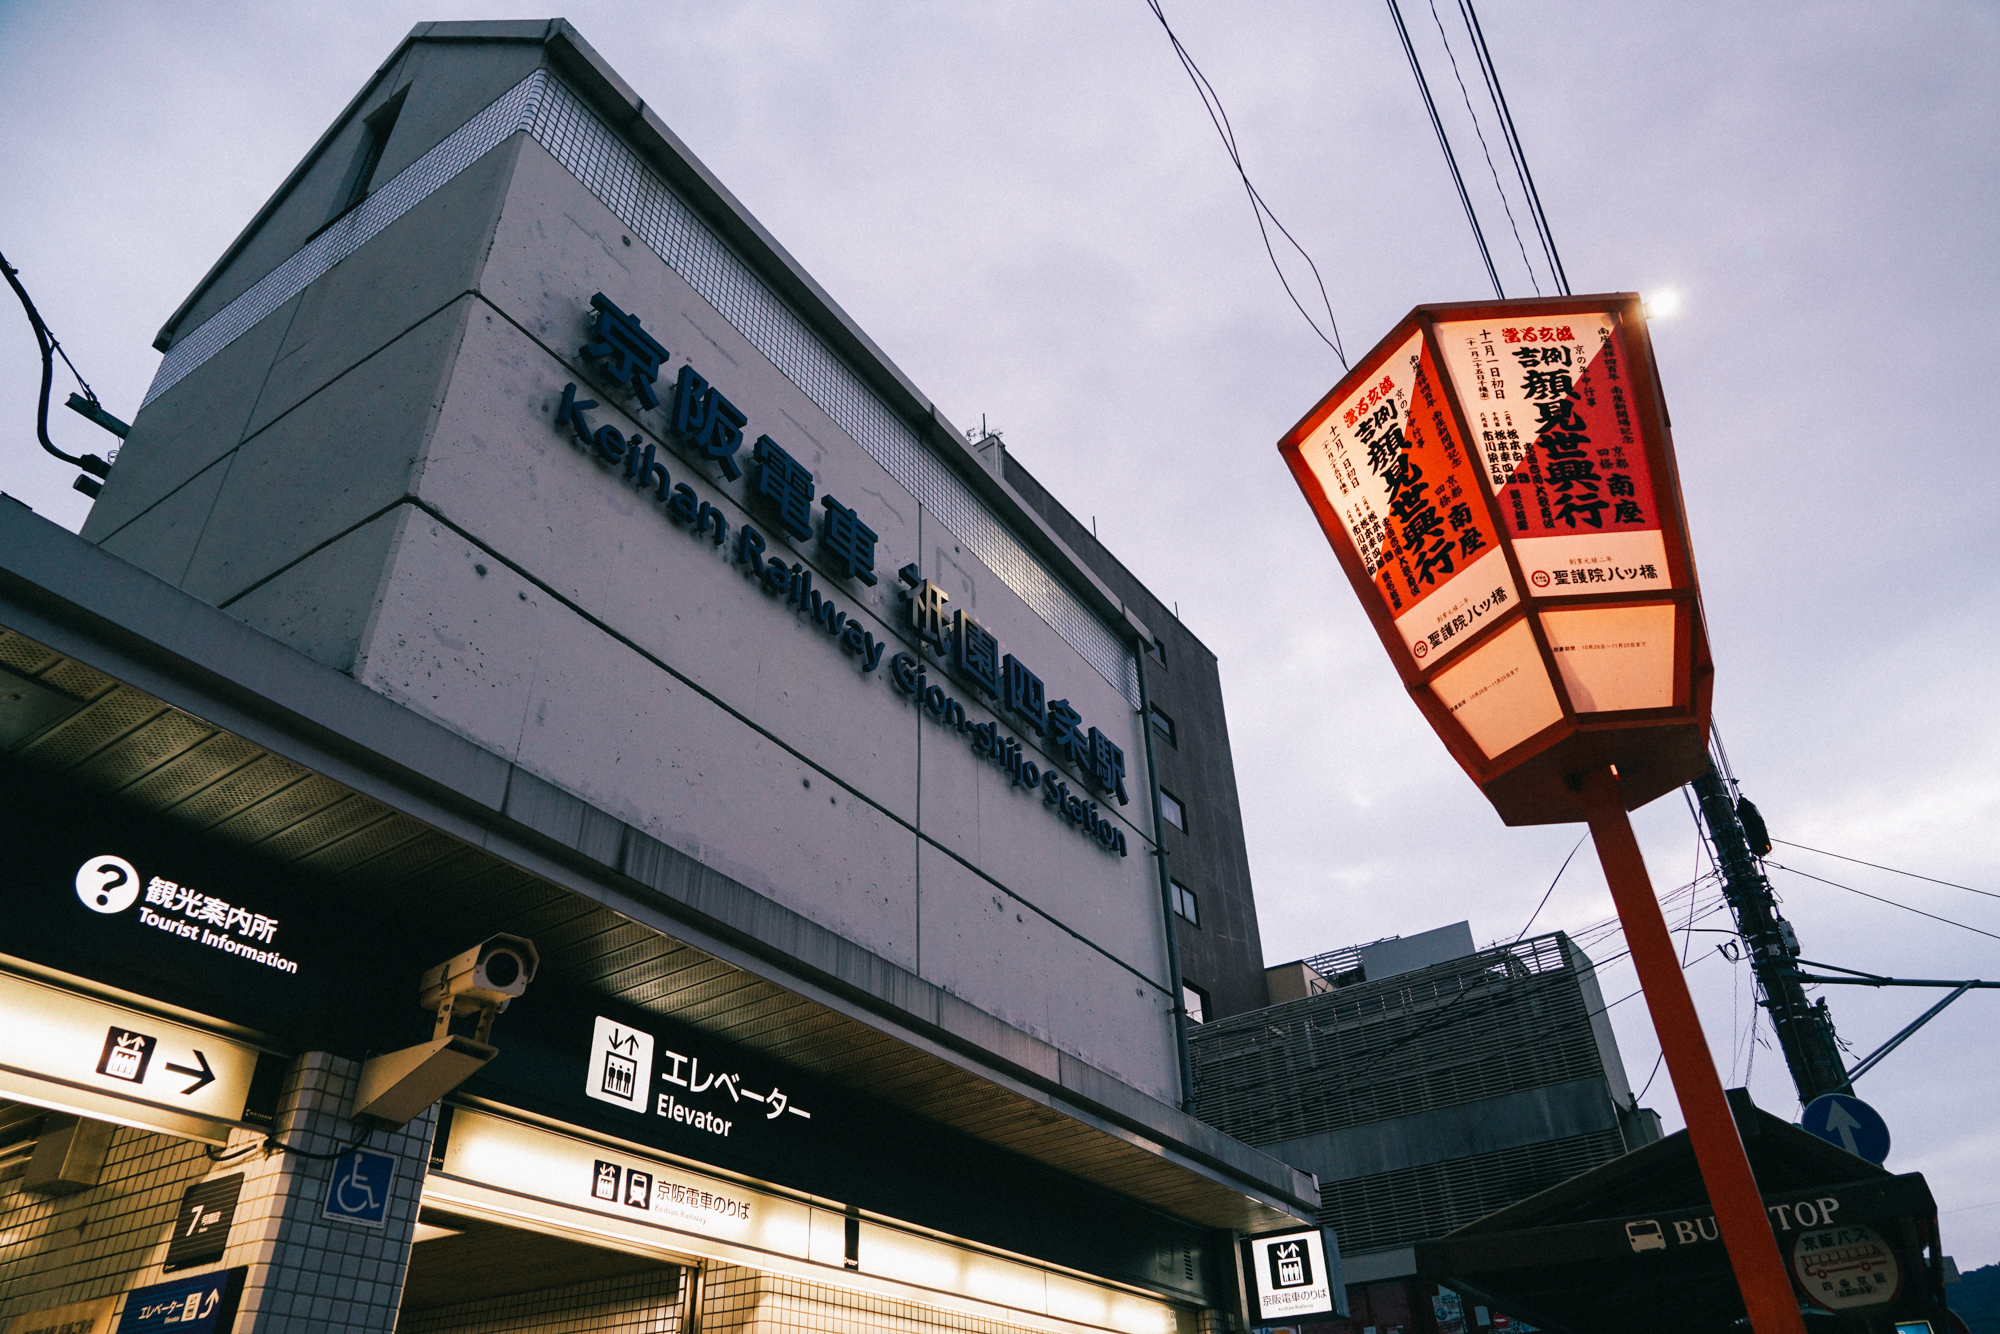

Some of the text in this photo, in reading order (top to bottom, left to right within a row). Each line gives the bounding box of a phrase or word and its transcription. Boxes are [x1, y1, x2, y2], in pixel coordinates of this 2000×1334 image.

[1479, 329, 1505, 400] 十一月一日初日
[1512, 345, 1572, 368] 吉例
[1573, 344, 1597, 408] 京の年中行事
[1354, 398, 1398, 444] 吉例
[1395, 387, 1425, 449] 京の年中行事
[1606, 473, 1645, 524] 南座
[578, 291, 1130, 806] 京阪電車 祇園四条駅
[1447, 501, 1487, 560] 南座
[556, 382, 1128, 858] Keihan Railway Gion-shijo Station
[145, 876, 279, 944] 観光案内所
[139, 906, 298, 974] Tourist Information
[661, 1049, 811, 1120] エレベーター
[656, 1093, 732, 1137] Elevator
[654, 1203, 707, 1225] Keihan Railway
[656, 1180, 751, 1220] 京阪電車のりば
[1672, 1197, 1840, 1245] BU TOP
[1801, 1228, 1870, 1251] 京阪バス
[1262, 1287, 1328, 1307] 京阪電車のりば
[1821, 1272, 1888, 1292] 四条京阪
[138, 1299, 185, 1320] エレベーター
